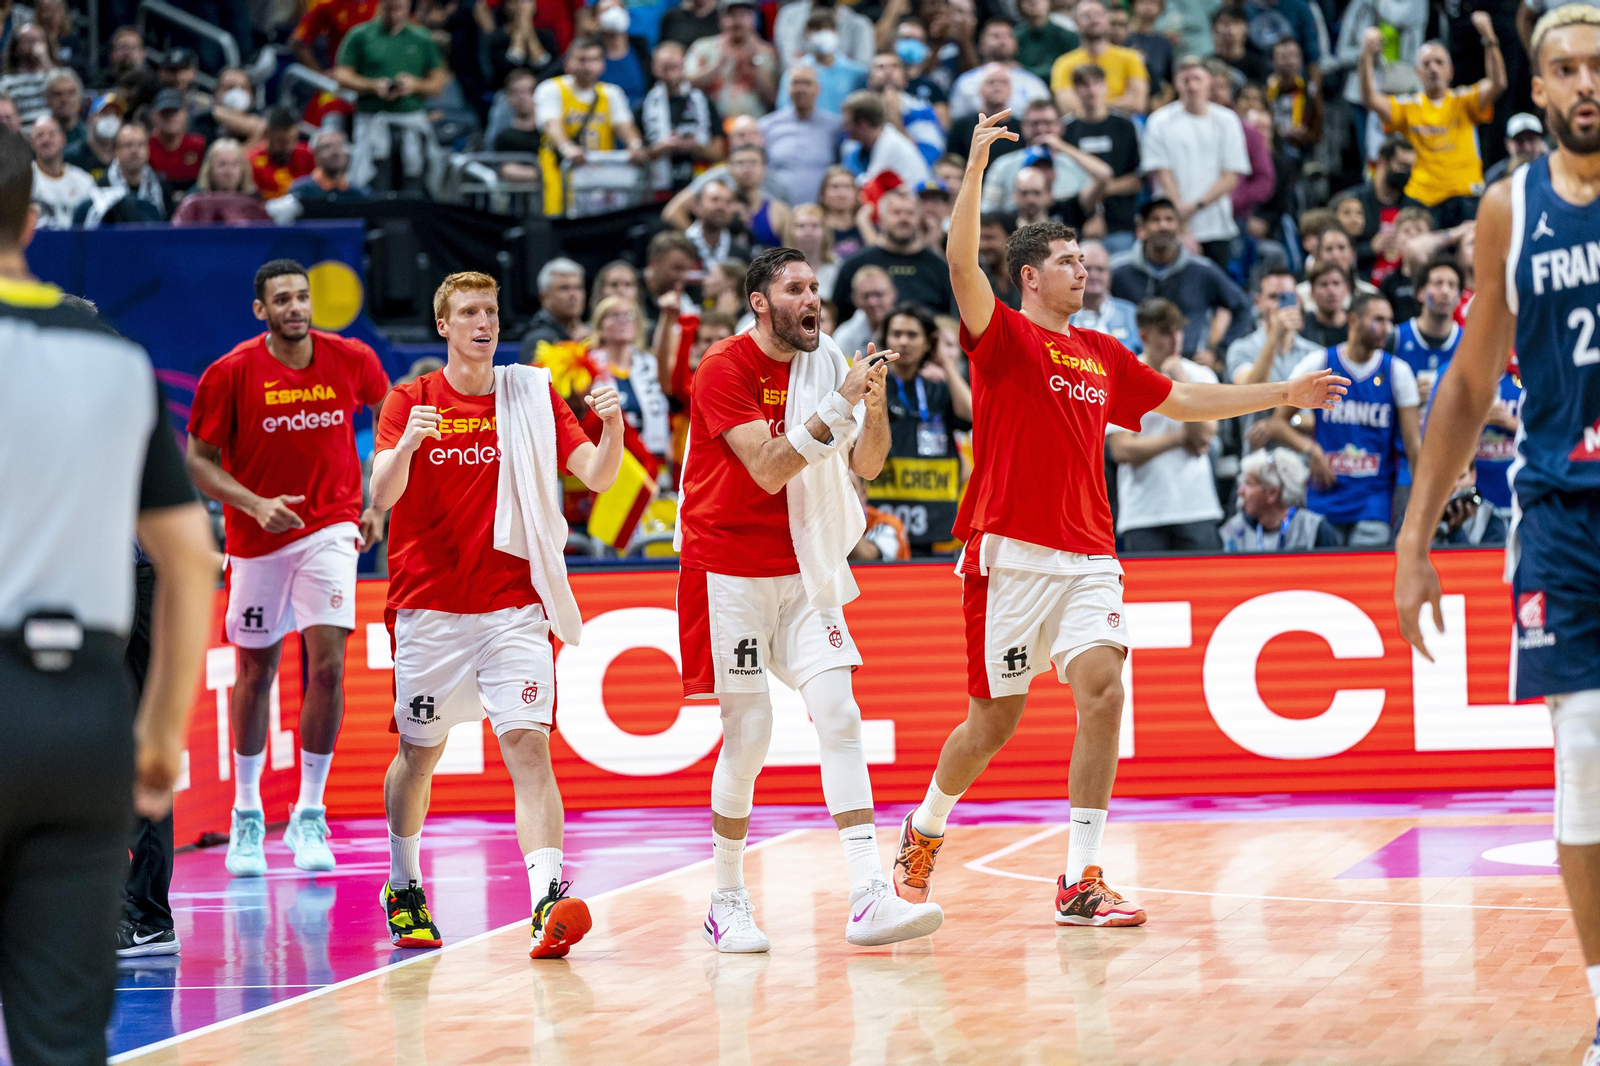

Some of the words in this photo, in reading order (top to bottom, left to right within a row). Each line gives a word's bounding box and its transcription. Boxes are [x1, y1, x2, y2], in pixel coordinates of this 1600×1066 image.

[1567, 303, 1600, 368] 2
[1049, 349, 1107, 376] ESPAÑA
[265, 384, 337, 405] ESPAÑA
[1049, 375, 1108, 406] endes
[262, 408, 344, 433] endesa
[438, 416, 497, 434] ESPA
[901, 468, 949, 491] CREW
[242, 606, 264, 628] fi
[733, 638, 758, 668] fi
[1003, 644, 1028, 672] fi
[728, 666, 764, 676] network
[406, 714, 442, 726] network
[409, 695, 435, 720] fi
